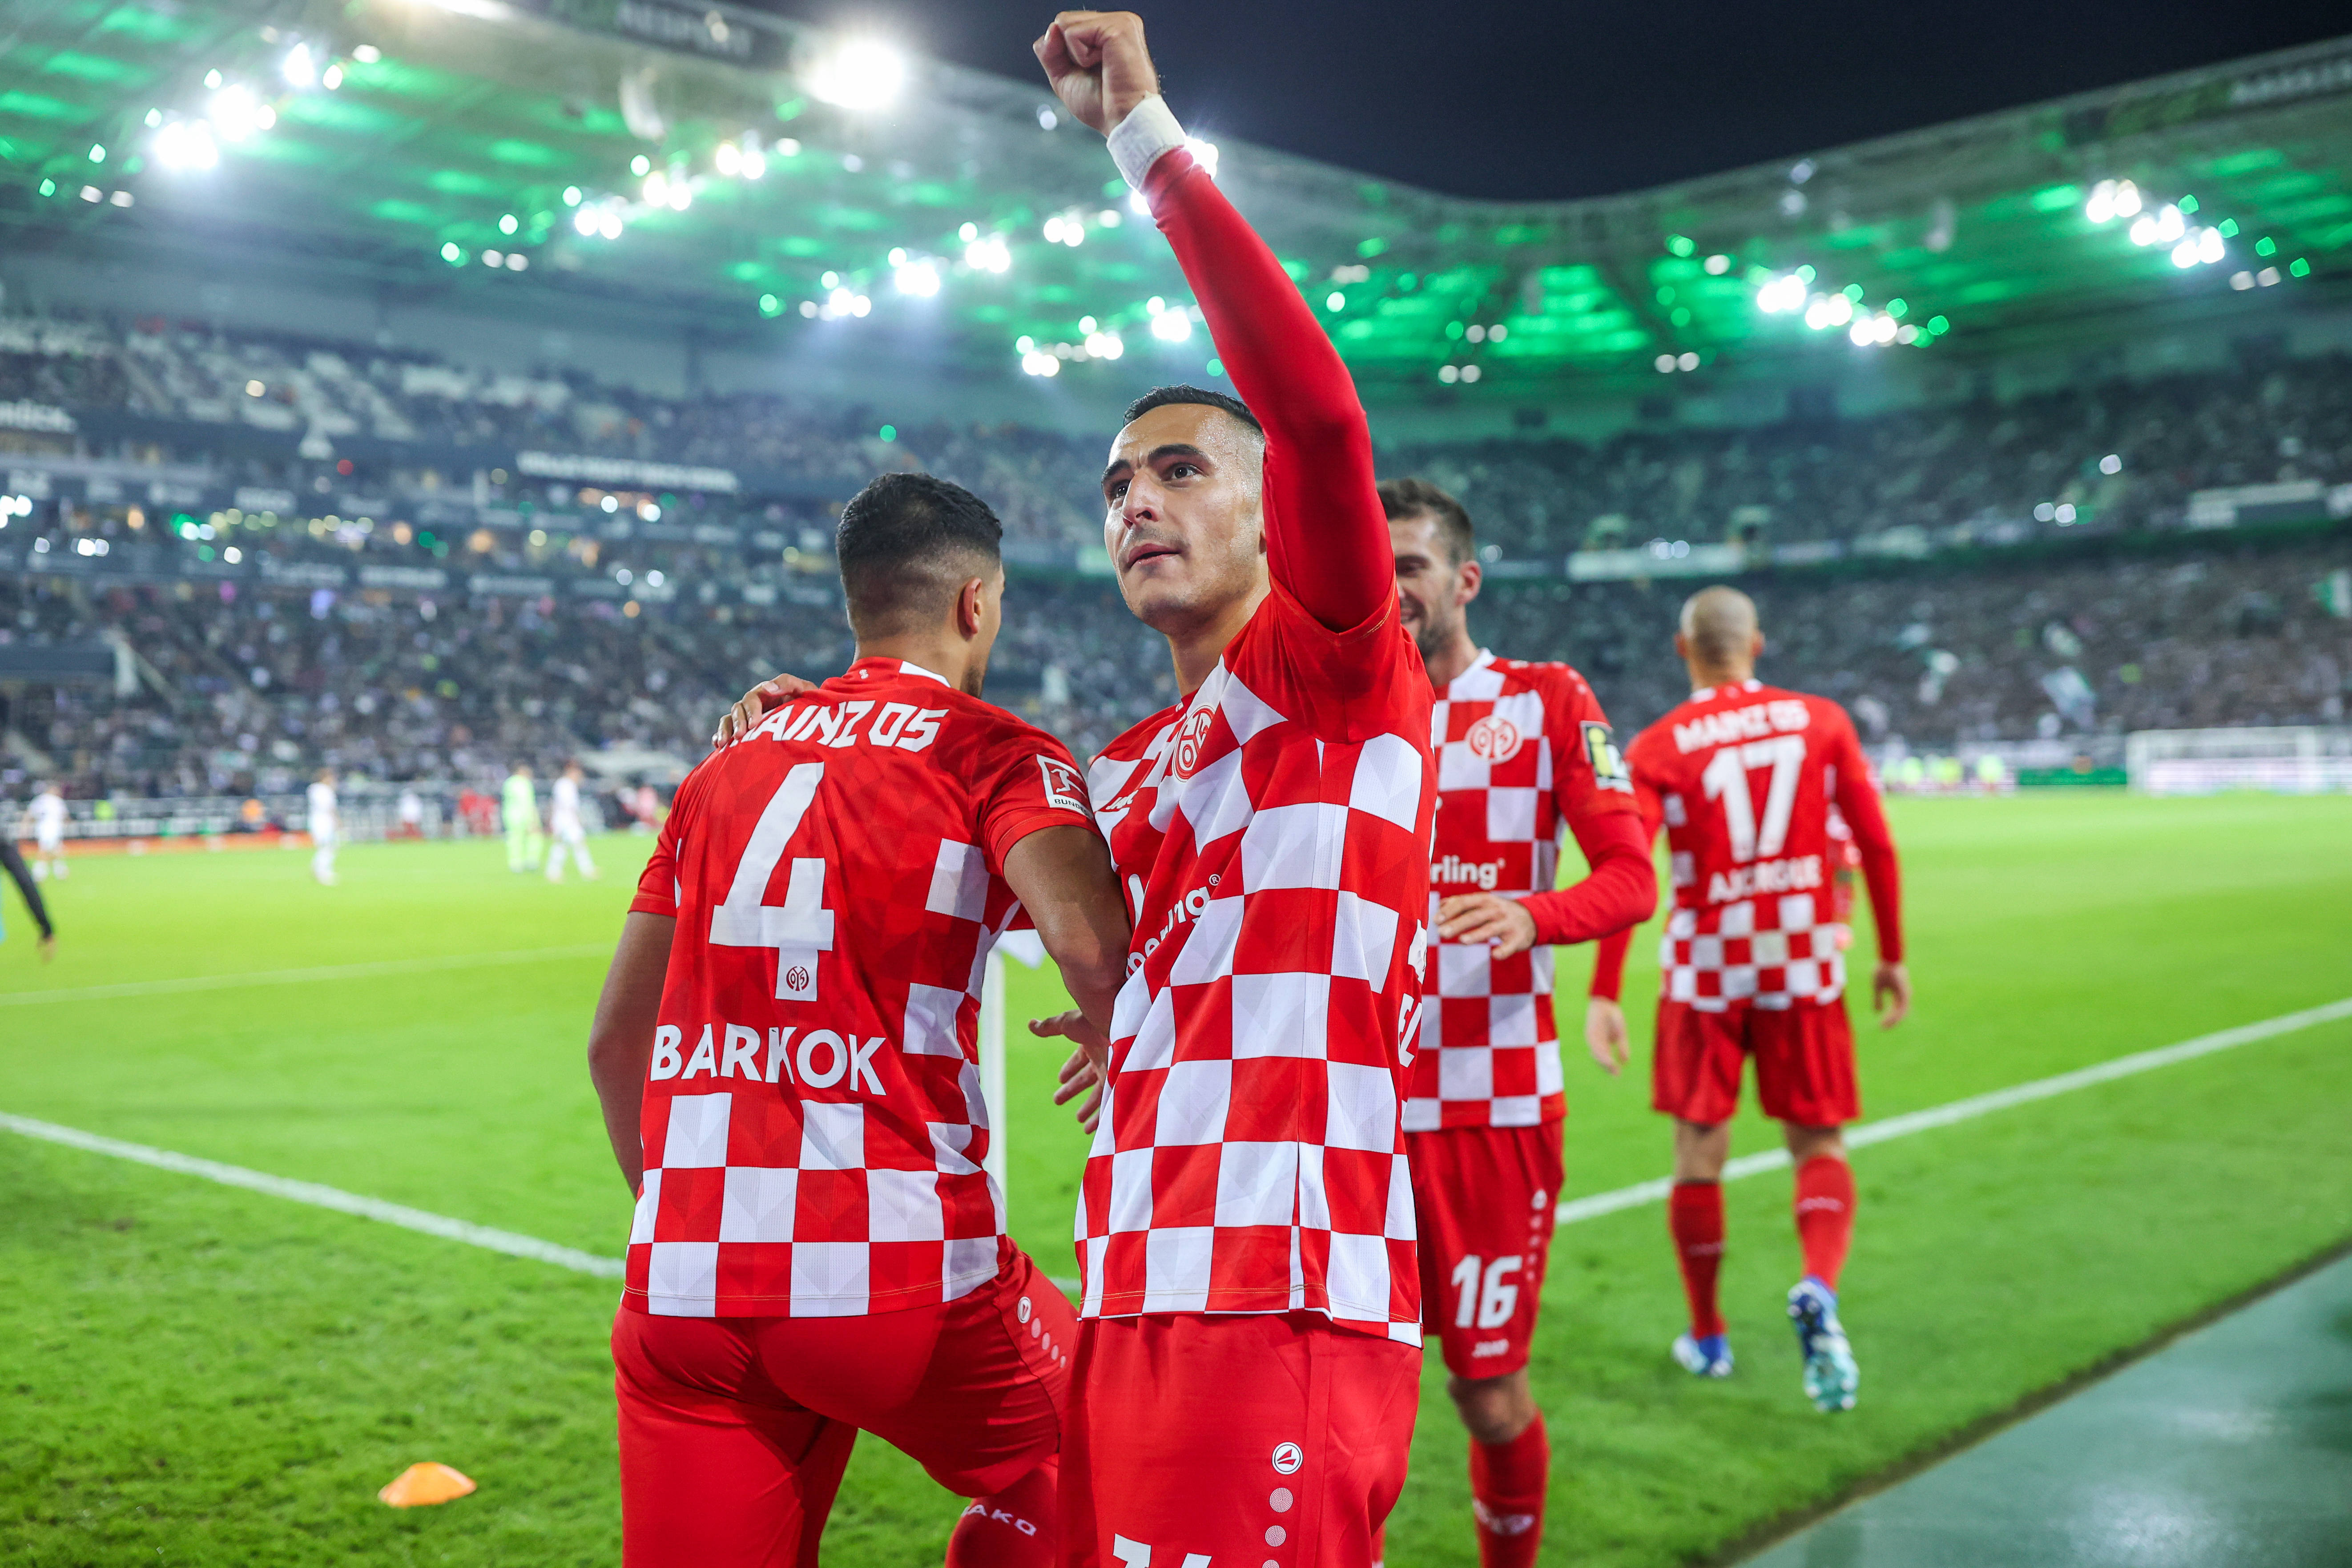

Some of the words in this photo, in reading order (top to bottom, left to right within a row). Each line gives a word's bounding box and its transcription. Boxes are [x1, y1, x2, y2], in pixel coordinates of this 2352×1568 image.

[868, 701, 949, 753] 05
[1701, 734, 1806, 863] 17
[709, 761, 834, 1002] 4
[650, 1023, 887, 1096] BARKOK
[1451, 1254, 1523, 1329] 16
